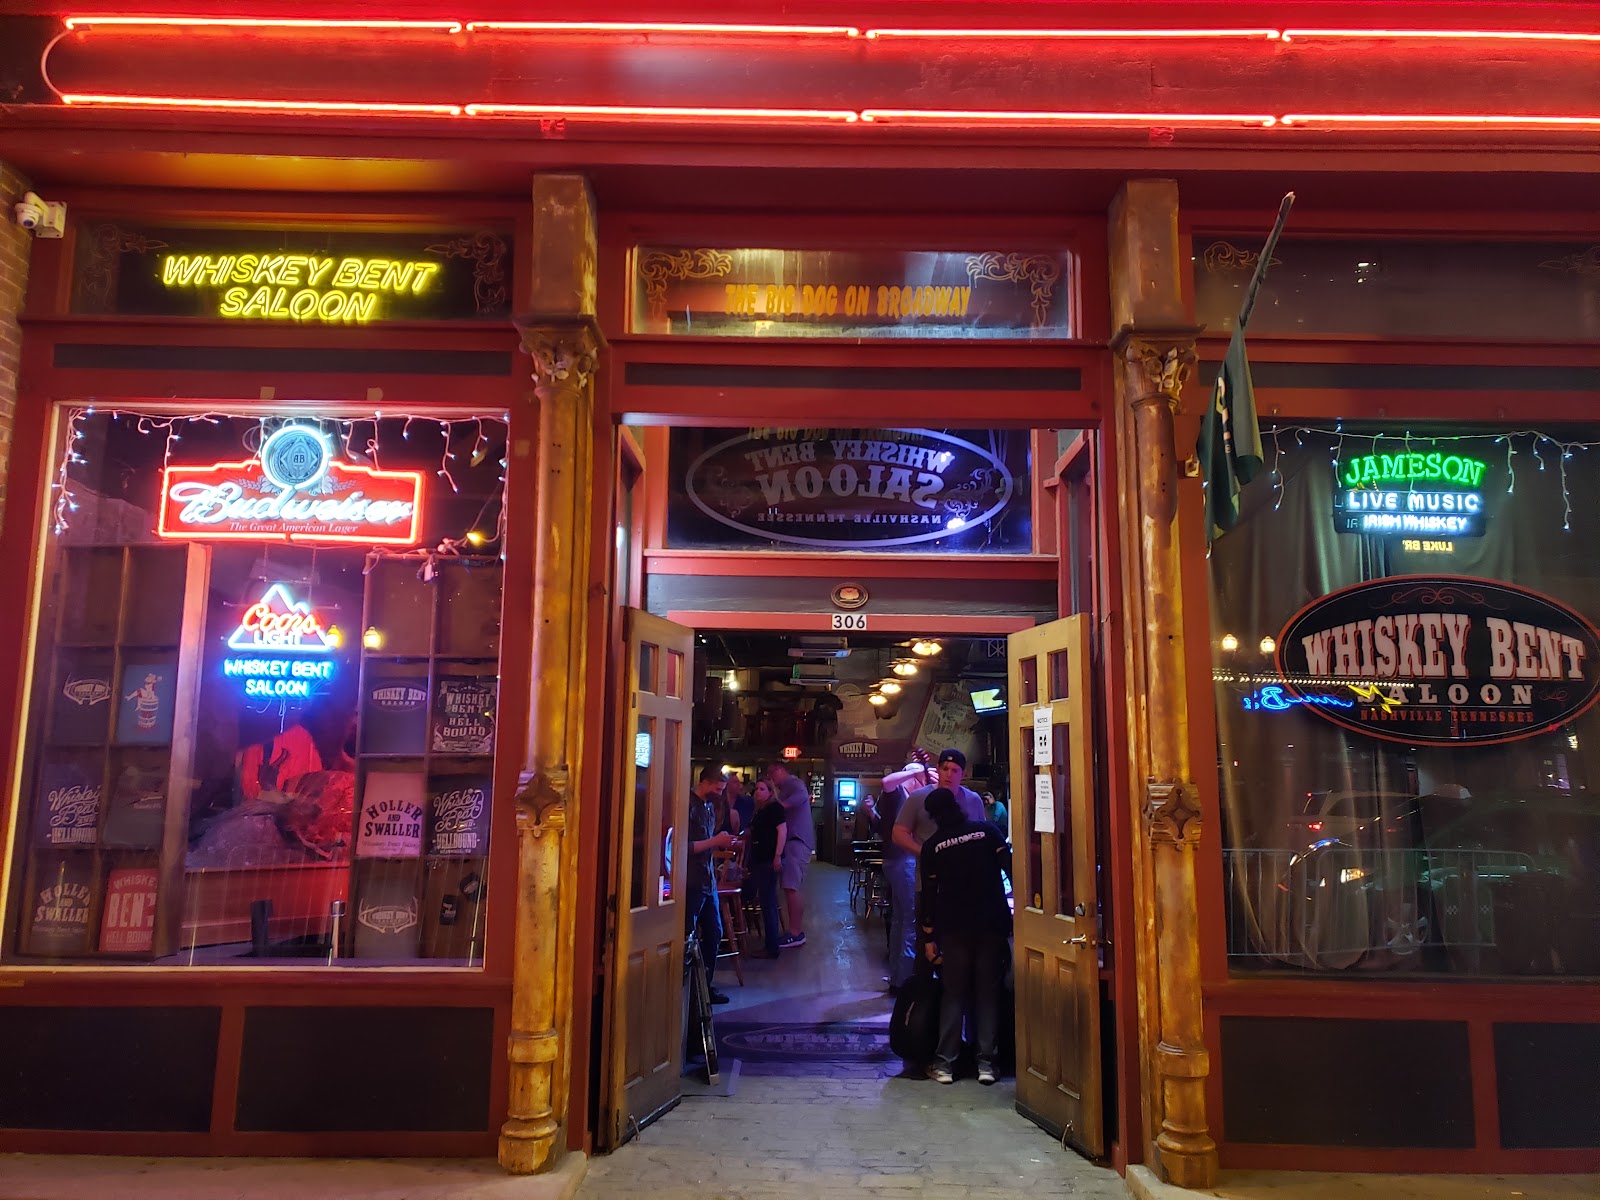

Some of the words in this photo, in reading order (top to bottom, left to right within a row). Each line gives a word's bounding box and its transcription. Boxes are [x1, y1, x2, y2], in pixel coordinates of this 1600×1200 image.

[162, 254, 331, 286] WHISKEY
[333, 258, 437, 292] BENT
[221, 286, 376, 320] SALOON
[725, 284, 757, 315] THE
[765, 284, 795, 316] BIG
[803, 284, 838, 317] DOG
[845, 285, 870, 316] ON
[877, 285, 971, 318] BROADWAY
[1345, 452, 1486, 486] JAMESON
[170, 481, 414, 525] Budweiser
[1349, 492, 1398, 509] LIVE
[1409, 493, 1479, 511] MUSIC
[229, 521, 248, 532] The
[250, 522, 277, 532] Great
[279, 522, 326, 533] American
[328, 523, 358, 534] Lager
[1364, 514, 1400, 528] IRISH
[1403, 514, 1467, 530] WHISKEY
[242, 602, 321, 634] Coors
[833, 615, 865, 629] 306
[253, 630, 303, 645] LIGHT
[1302, 613, 1472, 679] WHISKEY
[1486, 616, 1587, 681] BENT
[223, 658, 291, 677] WHISKEY
[291, 660, 333, 679] BENT
[246, 679, 309, 696] SALOON
[372, 687, 406, 700] WHISKEY
[407, 688, 427, 701] BENT
[1358, 683, 1534, 705] SALOON
[446, 692, 491, 708] WHISKEY
[451, 704, 484, 714] BENT
[1361, 709, 1442, 722] NASHVILLE
[1451, 709, 1534, 723] TENNESSEE
[448, 717, 481, 727] HELL
[443, 727, 486, 738] BOUND
[784, 747, 798, 758] EXIT
[366, 799, 423, 821] HOLLER
[387, 813, 401, 821] AND
[364, 822, 420, 839] SWALLER
